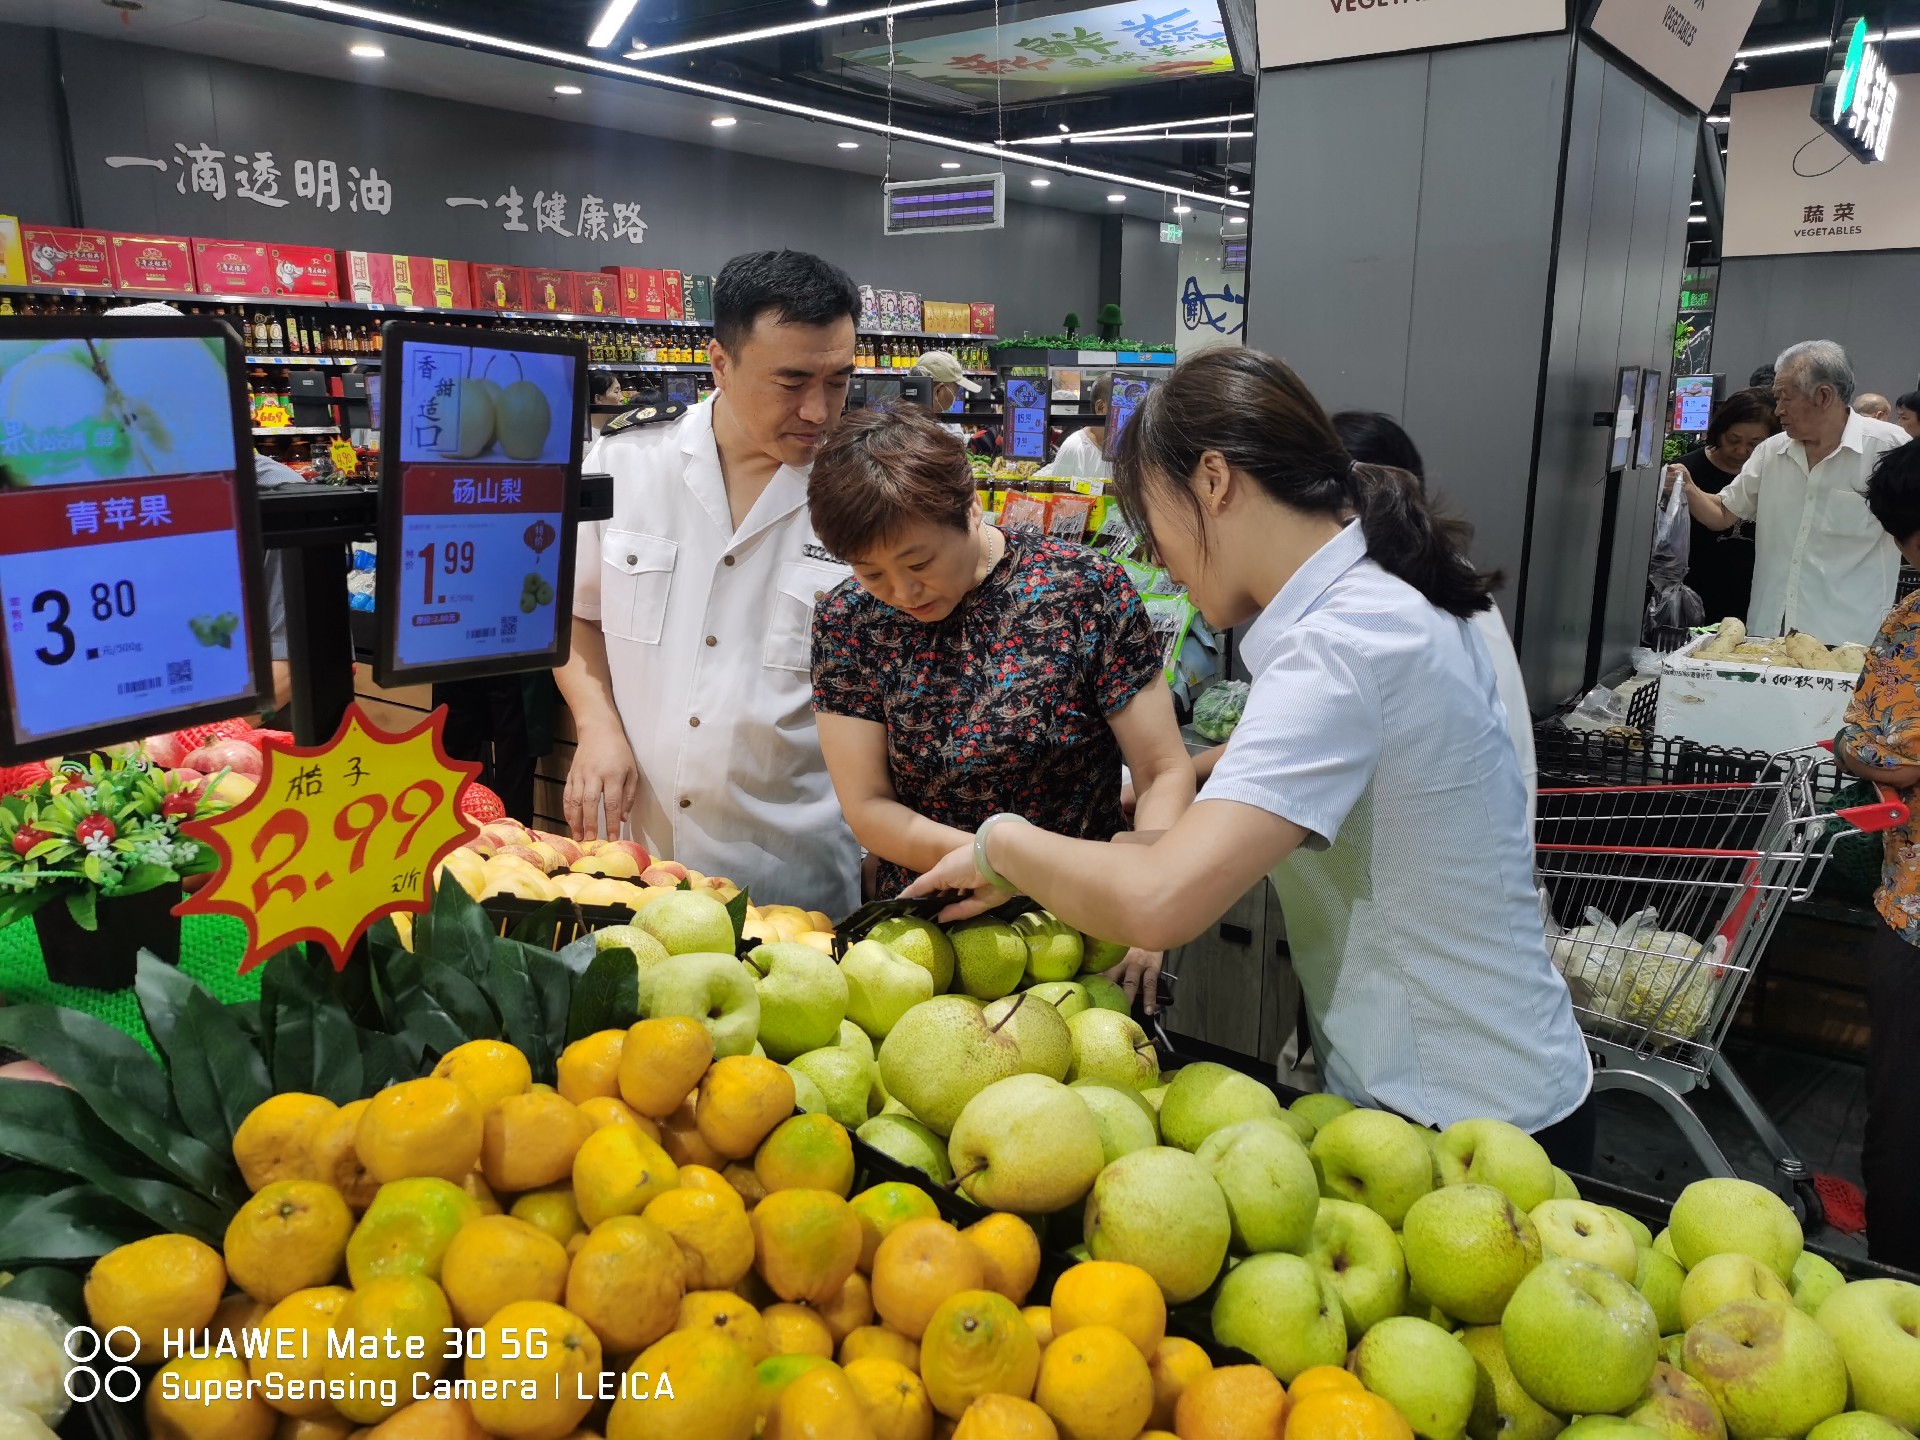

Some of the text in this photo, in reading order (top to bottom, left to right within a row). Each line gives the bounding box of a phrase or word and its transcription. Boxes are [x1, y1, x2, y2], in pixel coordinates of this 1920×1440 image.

[105, 142, 649, 244] 一滴透明油 一生健康路
[1802, 202, 1856, 224] 蔬菜
[1793, 225, 1863, 238] VEGETABLES
[452, 478, 523, 505] 砀山梨
[65, 493, 173, 536] 青苹果
[285, 756, 371, 803] 桔子
[251, 779, 445, 914] 2.99
